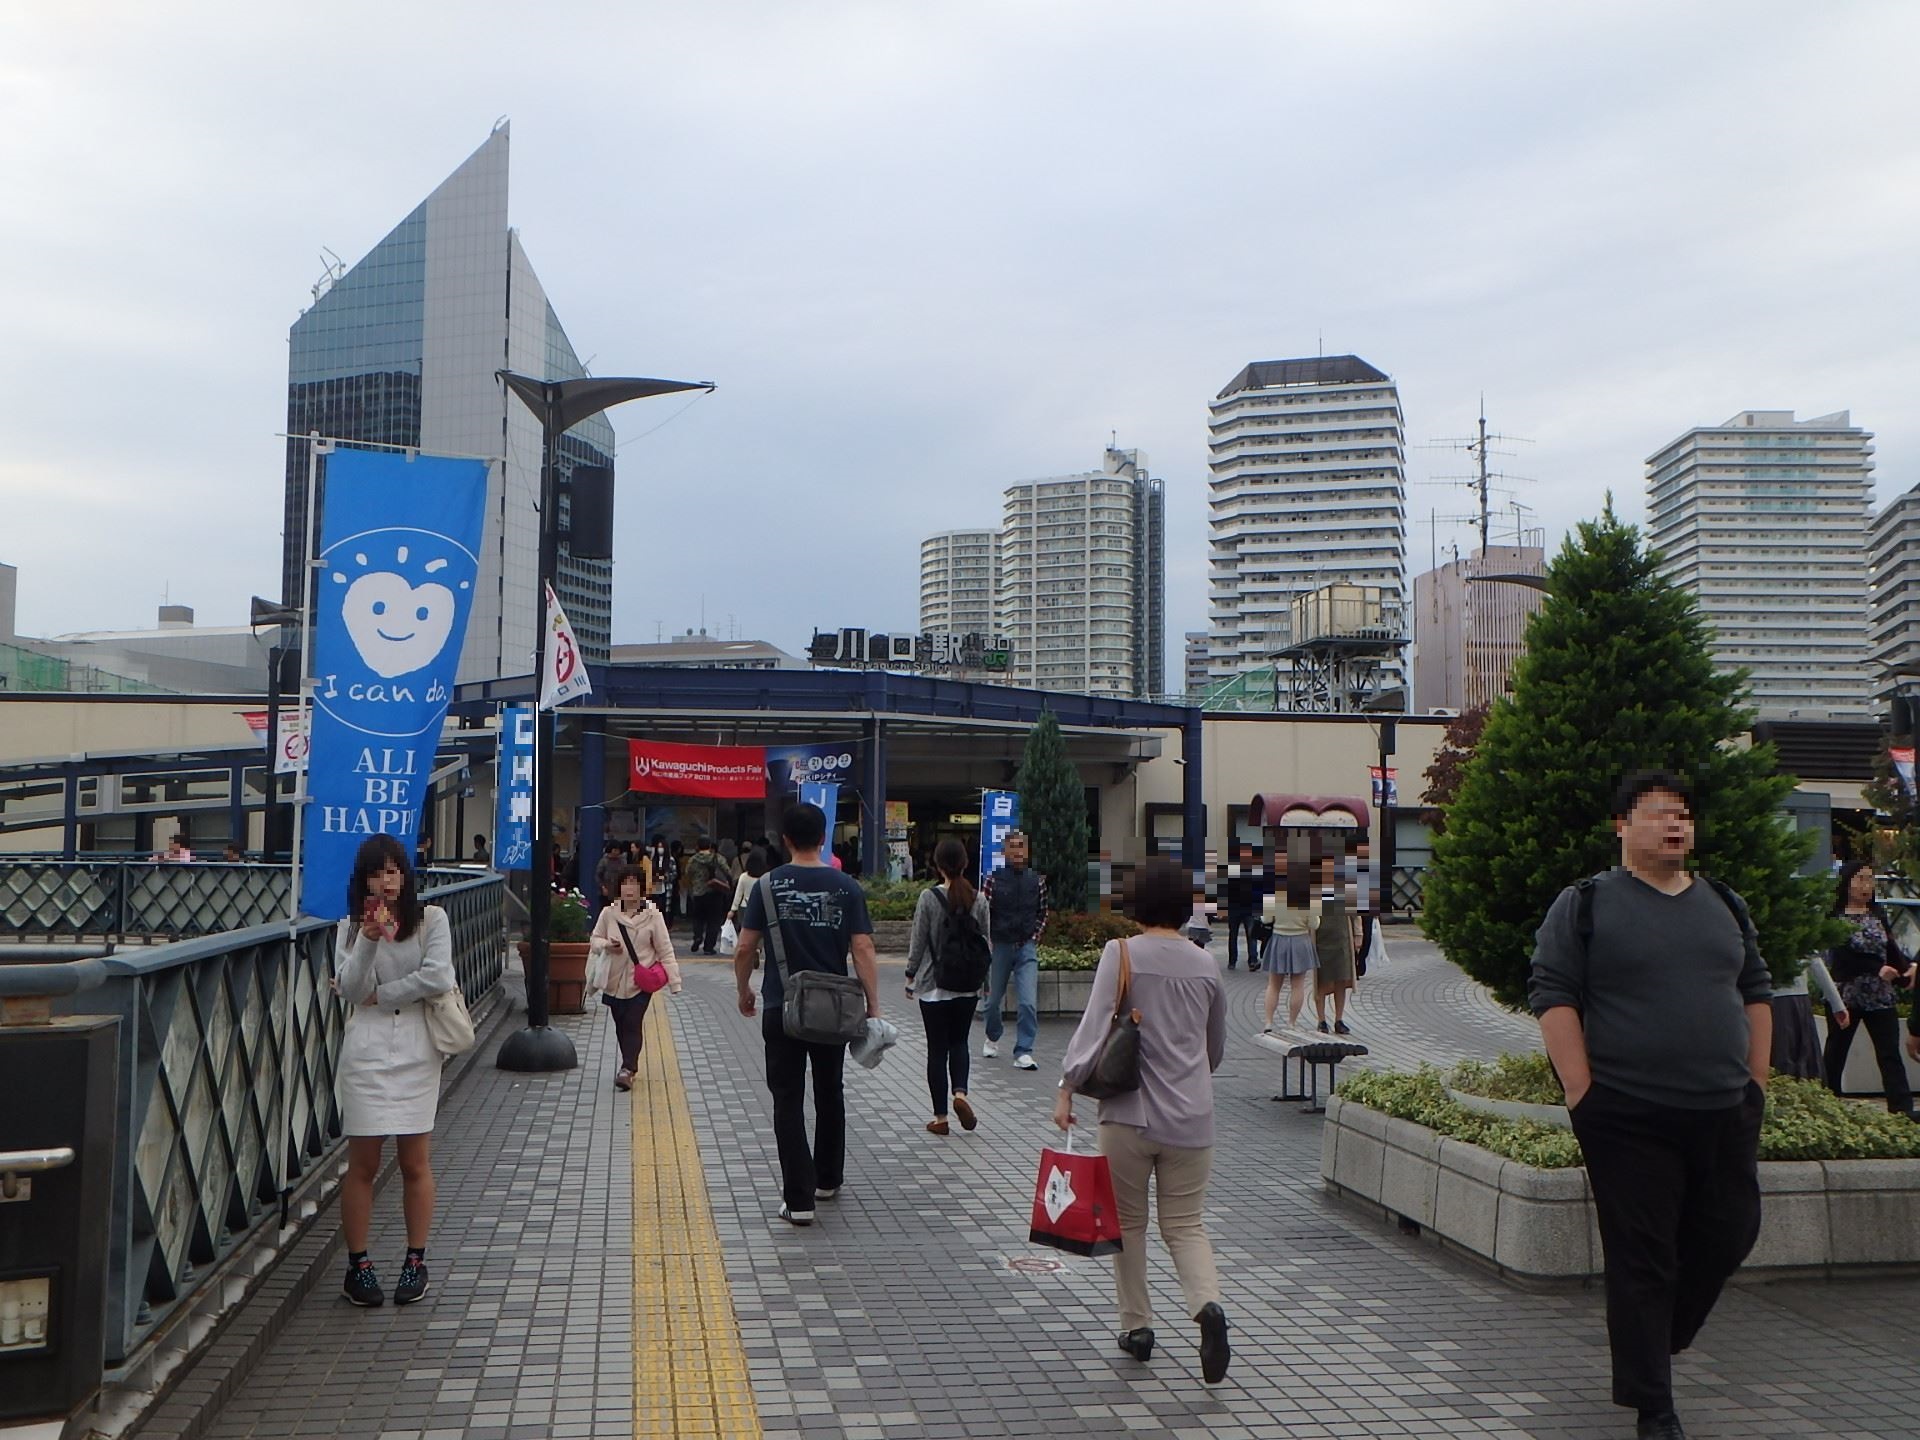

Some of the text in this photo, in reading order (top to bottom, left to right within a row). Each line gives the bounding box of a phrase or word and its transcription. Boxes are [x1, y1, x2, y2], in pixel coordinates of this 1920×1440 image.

[834, 628, 1010, 665] 川口駅 東口
[850, 661, 950, 672] Kawaguchi Station
[983, 652, 1008, 665] JR
[323, 674, 339, 699] I
[348, 683, 415, 703] can
[651, 758, 763, 774] Kawaguchi Products Fair
[363, 778, 410, 805] BE
